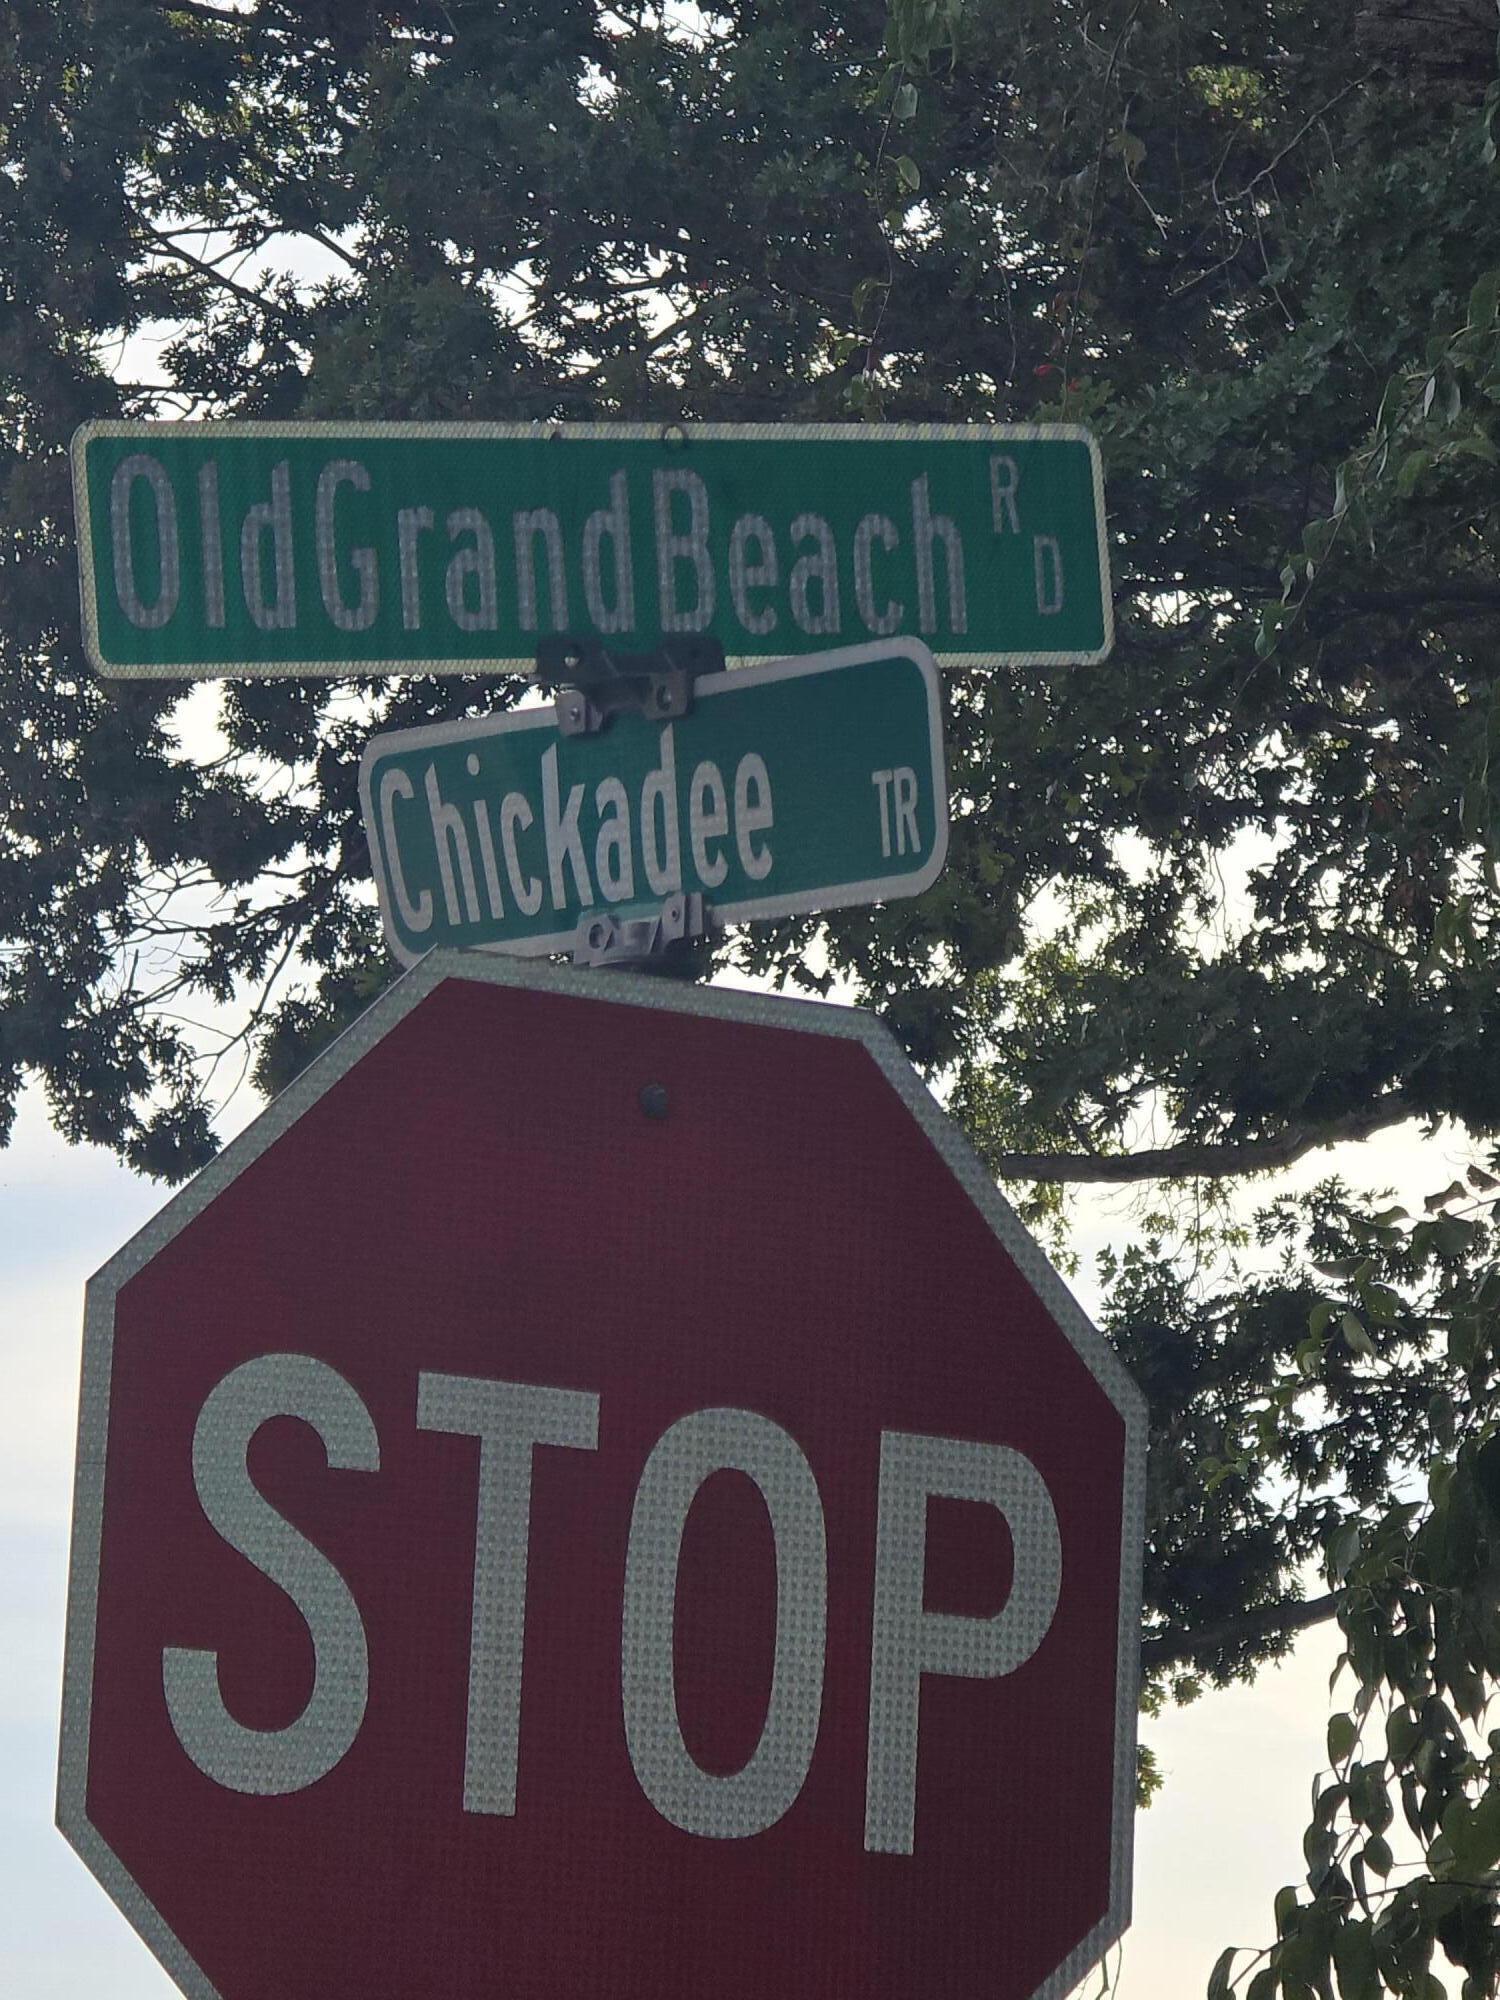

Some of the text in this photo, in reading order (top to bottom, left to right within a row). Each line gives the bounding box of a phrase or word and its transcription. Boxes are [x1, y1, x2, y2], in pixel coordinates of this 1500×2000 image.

[379, 722, 922, 934] Chickadee TR
[162, 1352, 1063, 1856] STOP
